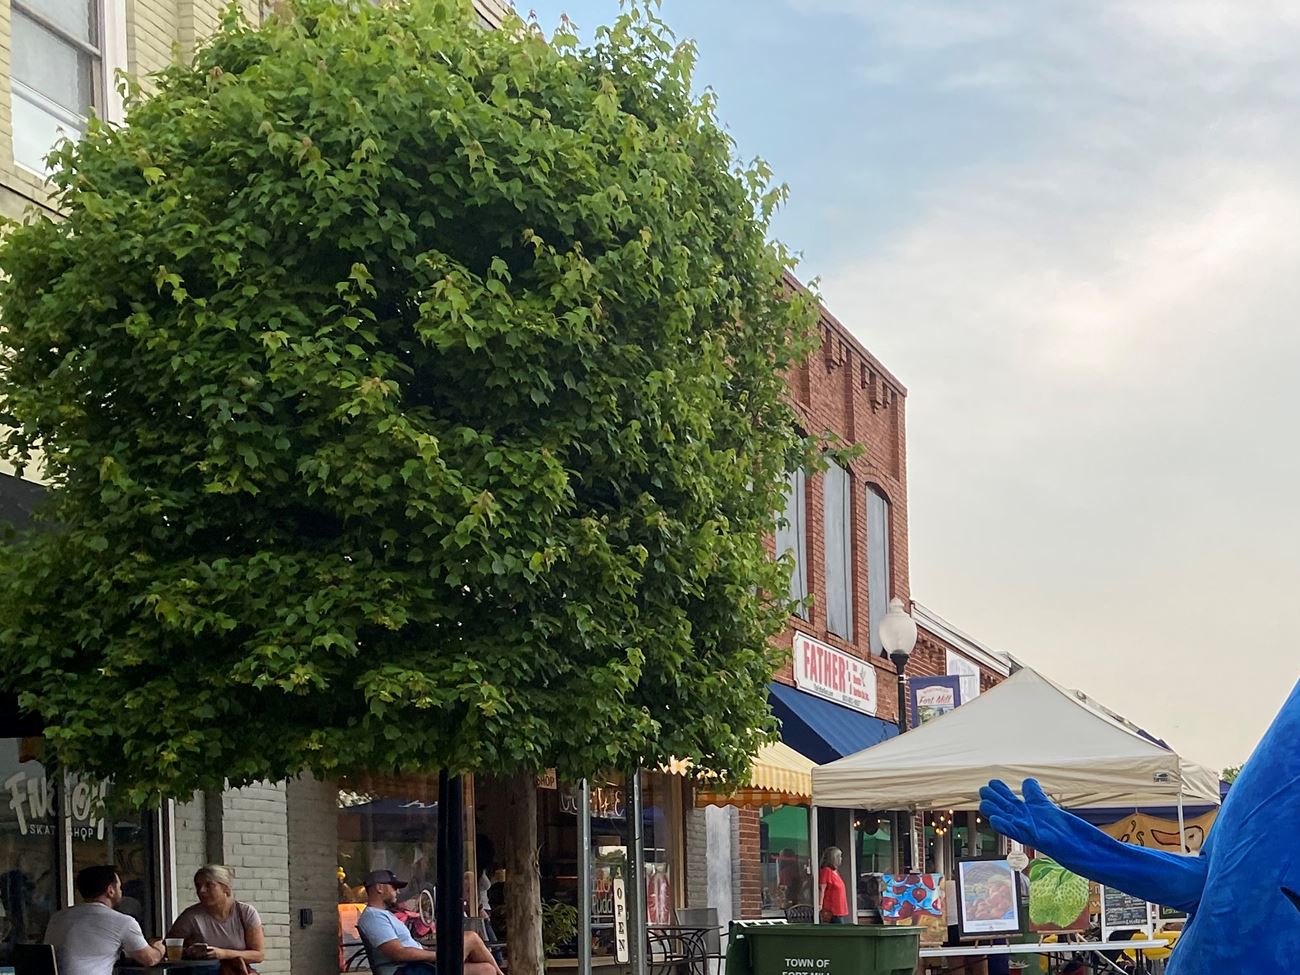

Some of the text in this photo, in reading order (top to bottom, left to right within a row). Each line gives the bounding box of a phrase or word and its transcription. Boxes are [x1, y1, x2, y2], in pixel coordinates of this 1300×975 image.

[803, 640, 846, 693] FATHER
[936, 695, 952, 704] Mill
[29, 824, 56, 835] SKAT
[616, 887, 627, 952] OPEN
[785, 958, 831, 968] TOWN OF
